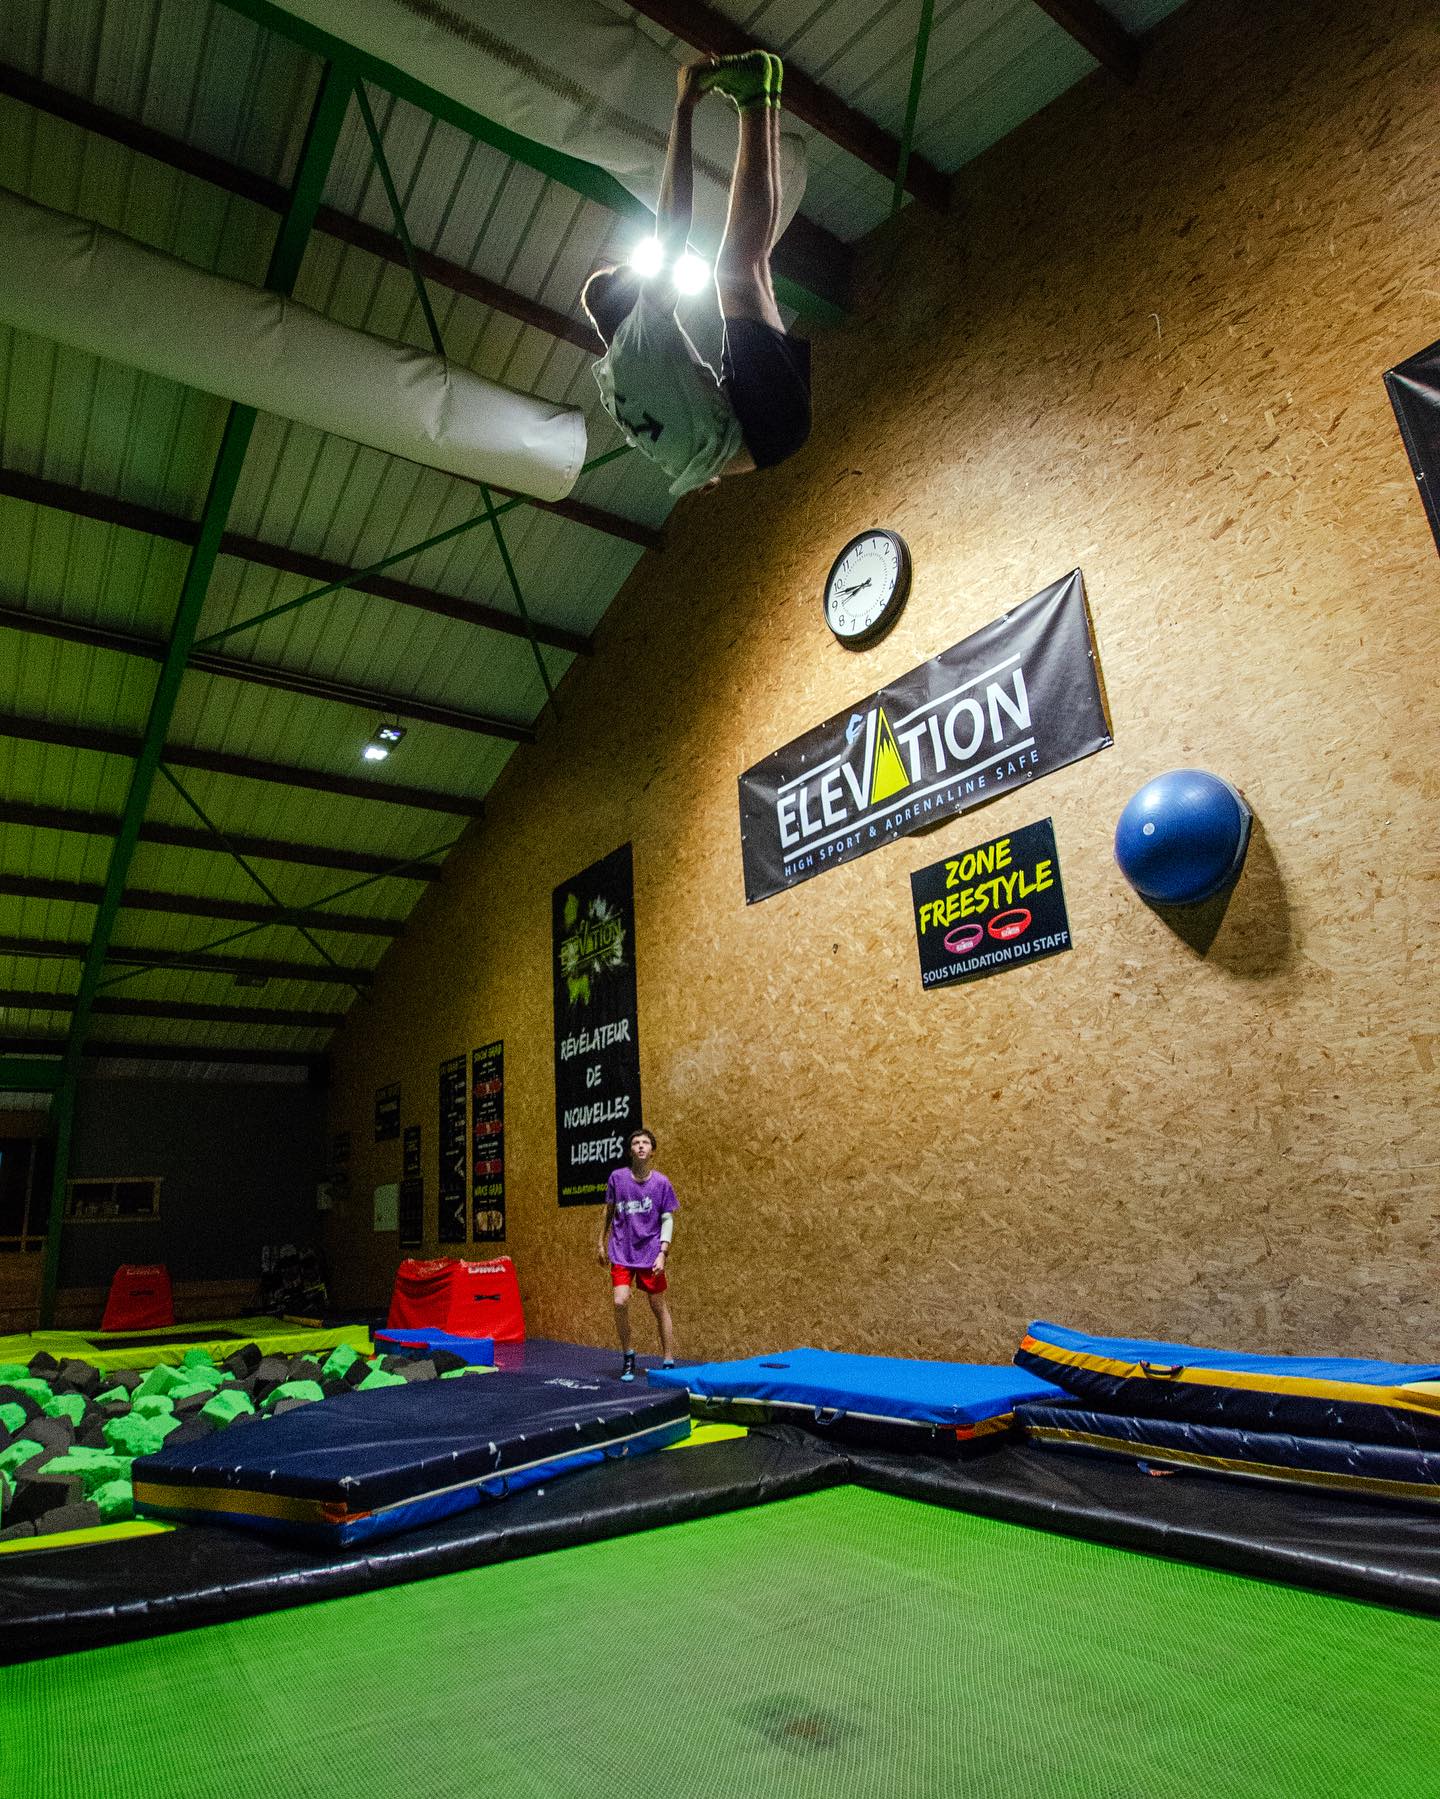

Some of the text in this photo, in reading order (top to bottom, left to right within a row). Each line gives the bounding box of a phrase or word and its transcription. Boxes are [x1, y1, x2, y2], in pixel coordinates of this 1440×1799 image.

[855, 543, 863, 557] 12
[872, 538, 877, 549] 1
[884, 542, 890, 555] 2
[842, 560, 850, 572] 11
[892, 556, 898, 569] 3
[833, 578, 843, 592] 10
[889, 578, 895, 590] 4
[831, 600, 838, 612] 9
[838, 614, 845, 627] 8
[851, 618, 856, 631] 7
[865, 615, 872, 627] 6
[784, 749, 1040, 877] HIGH SPORT & ADRENALINE SAFE
[945, 838, 1012, 889] ZONE
[919, 859, 1054, 935] FREESTYLE
[560, 917, 623, 967] EVATION
[923, 966, 949, 984] SOUS
[949, 947, 1012, 976] VALIDATION
[1014, 942, 1031, 957] DU
[1034, 931, 1069, 952] STAFF
[560, 1018, 631, 1061] RÉVÉLATEUR
[586, 1064, 602, 1089] DE
[563, 1095, 630, 1129] NOUVELLES
[571, 1130, 624, 1166] LIBERTÉS
